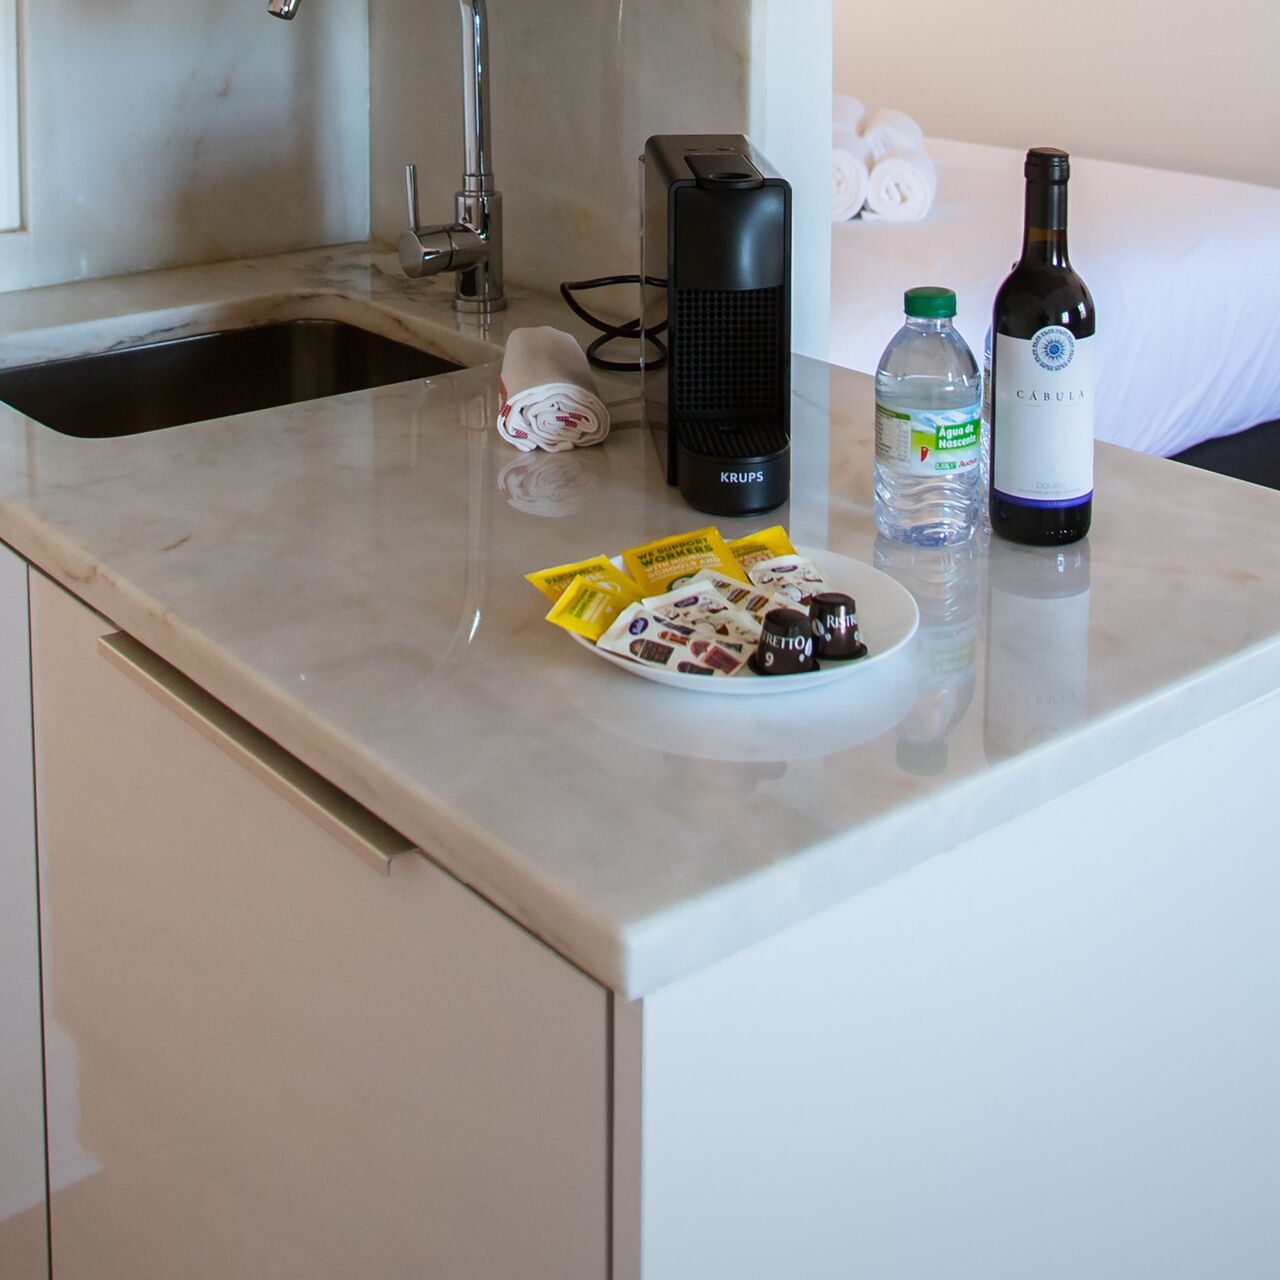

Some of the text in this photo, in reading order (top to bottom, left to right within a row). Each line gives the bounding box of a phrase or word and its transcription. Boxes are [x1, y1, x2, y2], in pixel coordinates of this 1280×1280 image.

[1016, 388, 1085, 402] CÁBULA
[938, 423, 975, 440] Água de
[938, 433, 977, 449] Nascente
[720, 471, 764, 483] KRUPS
[637, 537, 708, 560] WE SUPPORT
[640, 544, 714, 567] WORKERS
[645, 561, 670, 572] WITH
[764, 651, 775, 667] 9
